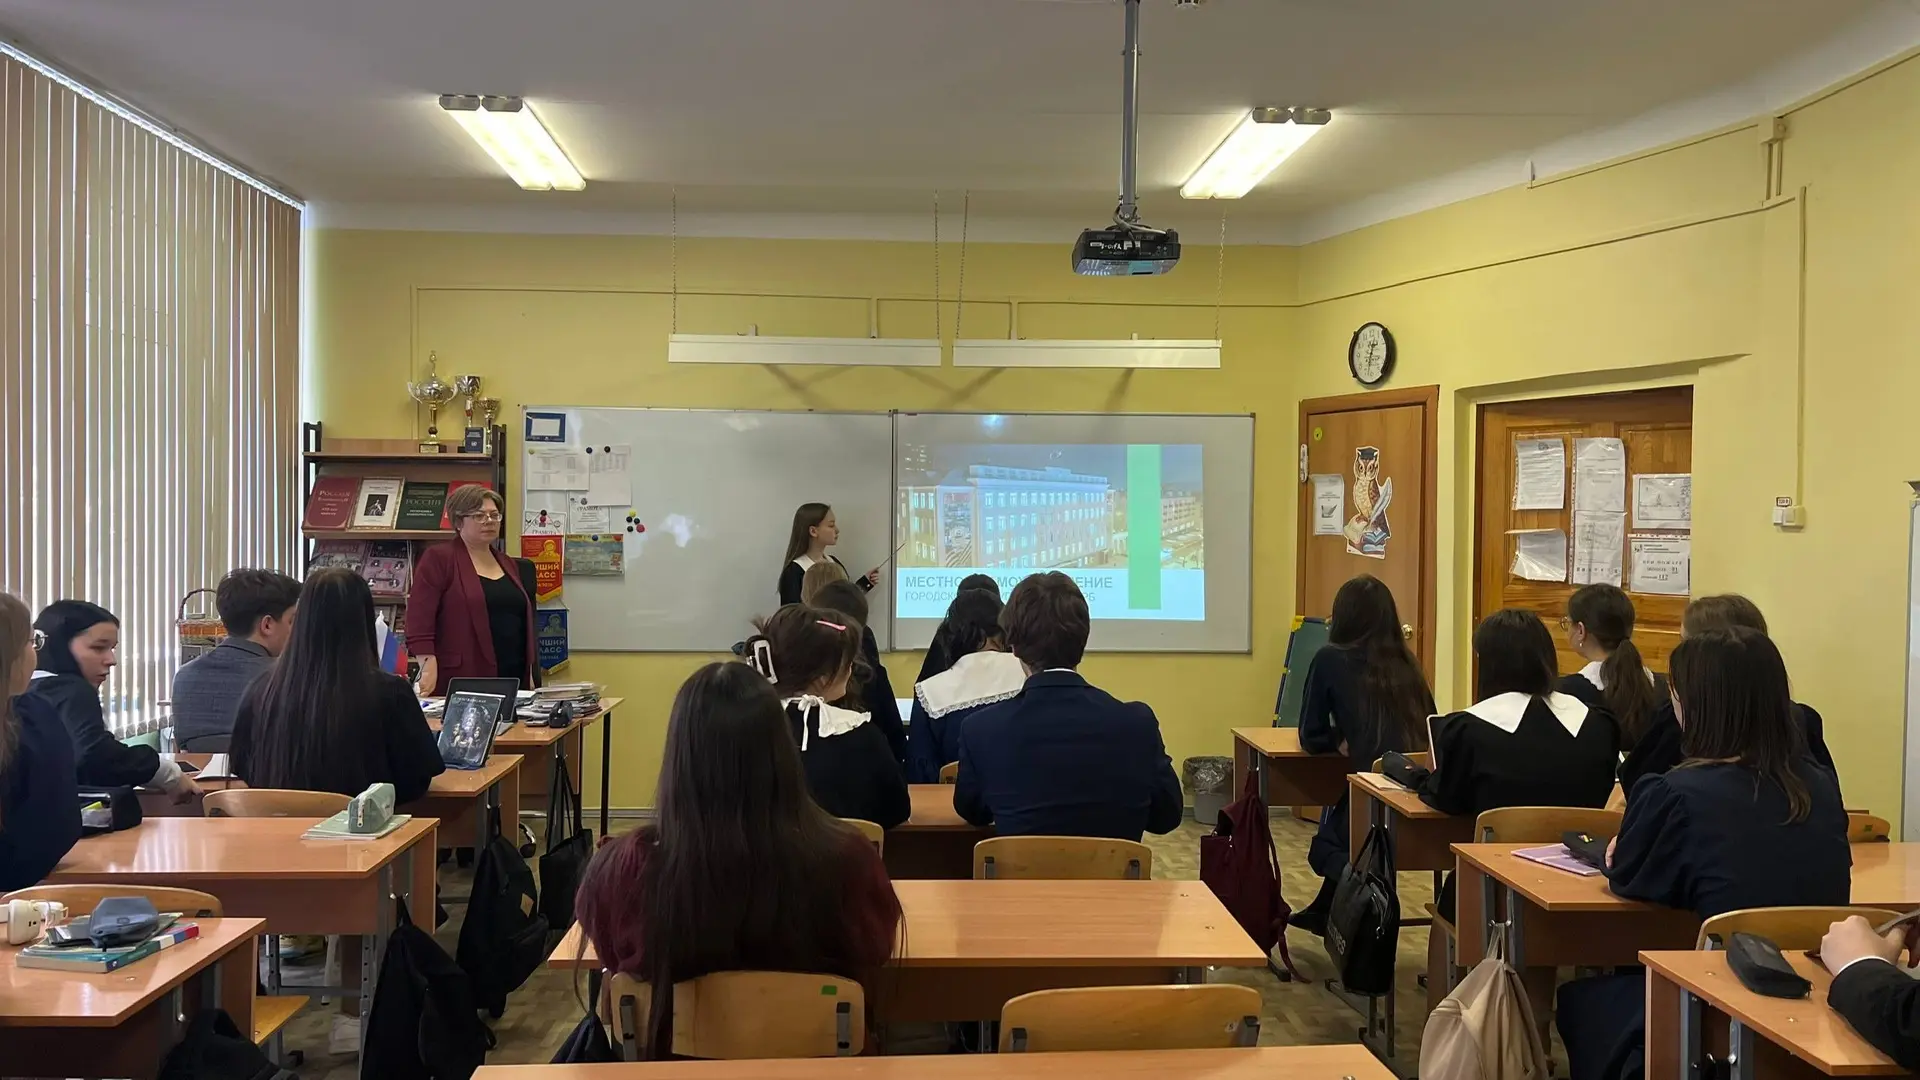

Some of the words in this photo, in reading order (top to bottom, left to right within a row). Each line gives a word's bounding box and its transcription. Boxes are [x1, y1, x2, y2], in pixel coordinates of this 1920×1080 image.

[535, 562, 560, 571] ЧШИЙ
[536, 571, 556, 579] АСС
[905, 576, 963, 588] МЕСТНО
[905, 591, 956, 602] ГОРОДСК
[539, 637, 565, 646] ЧШИЙ
